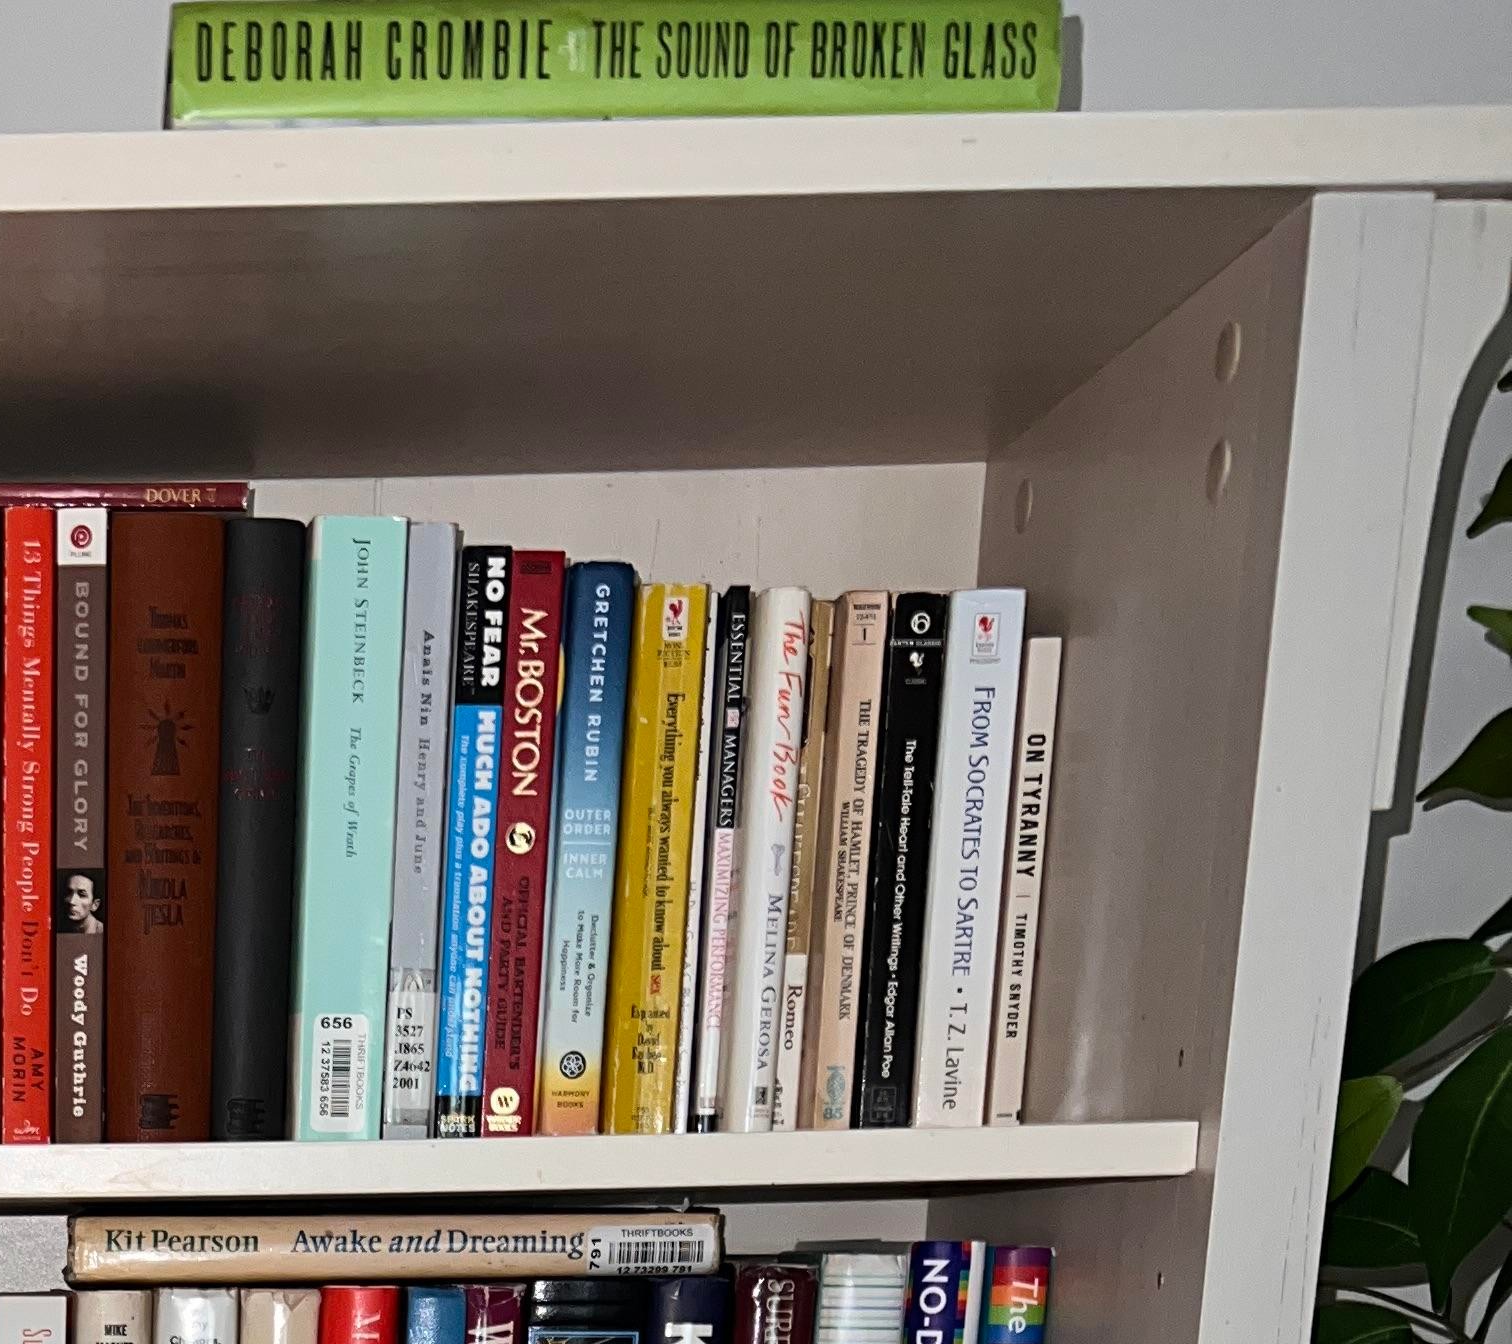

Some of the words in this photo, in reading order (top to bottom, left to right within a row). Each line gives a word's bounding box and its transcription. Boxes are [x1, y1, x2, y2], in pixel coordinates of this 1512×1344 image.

[196, 21, 363, 83] DEBORAH
[386, 20, 551, 82] CROMBIE
[592, 20, 641, 80] THE
[657, 20, 749, 80] SOUND
[766, 21, 800, 79] OF
[811, 20, 924, 79] BROKEN
[943, 21, 1038, 80] GLASS
[145, 487, 200, 504] DOVER
[485, 556, 506, 603] NO
[480, 610, 504, 688] FEAR
[518, 607, 549, 656] Mr.
[587, 583, 611, 703] GRETCHEN
[511, 659, 545, 797] BOSTON
[583, 714, 602, 783] RUBIN
[970, 685, 996, 749] FROM
[1025, 733, 1047, 765] ON
[473, 710, 497, 791] MUCH
[470, 796, 492, 860] ADO
[563, 822, 612, 836] ORDER
[564, 809, 613, 822] OUTER
[960, 754, 989, 861] SOCRATES
[1016, 773, 1044, 878] TYRANNY
[958, 867, 979, 892] TO
[465, 864, 489, 963] ABOUT
[951, 897, 979, 976] SARTRE
[1010, 913, 1028, 978] TIMOTHY
[72, 954, 88, 1029] Woody
[1005, 983, 1023, 1039] SNYDER
[321, 1017, 353, 1031] 656
[458, 967, 483, 1093] NOTHING
[71, 1031, 86, 1119] Guthrie
[105, 1229, 146, 1254] Kit
[154, 1229, 260, 1255] Pearson
[292, 1229, 383, 1254] Awake
[389, 1229, 441, 1254] and
[447, 1229, 585, 1259] Dreaming
[621, 1227, 695, 1238] THRIFTBOOKS
